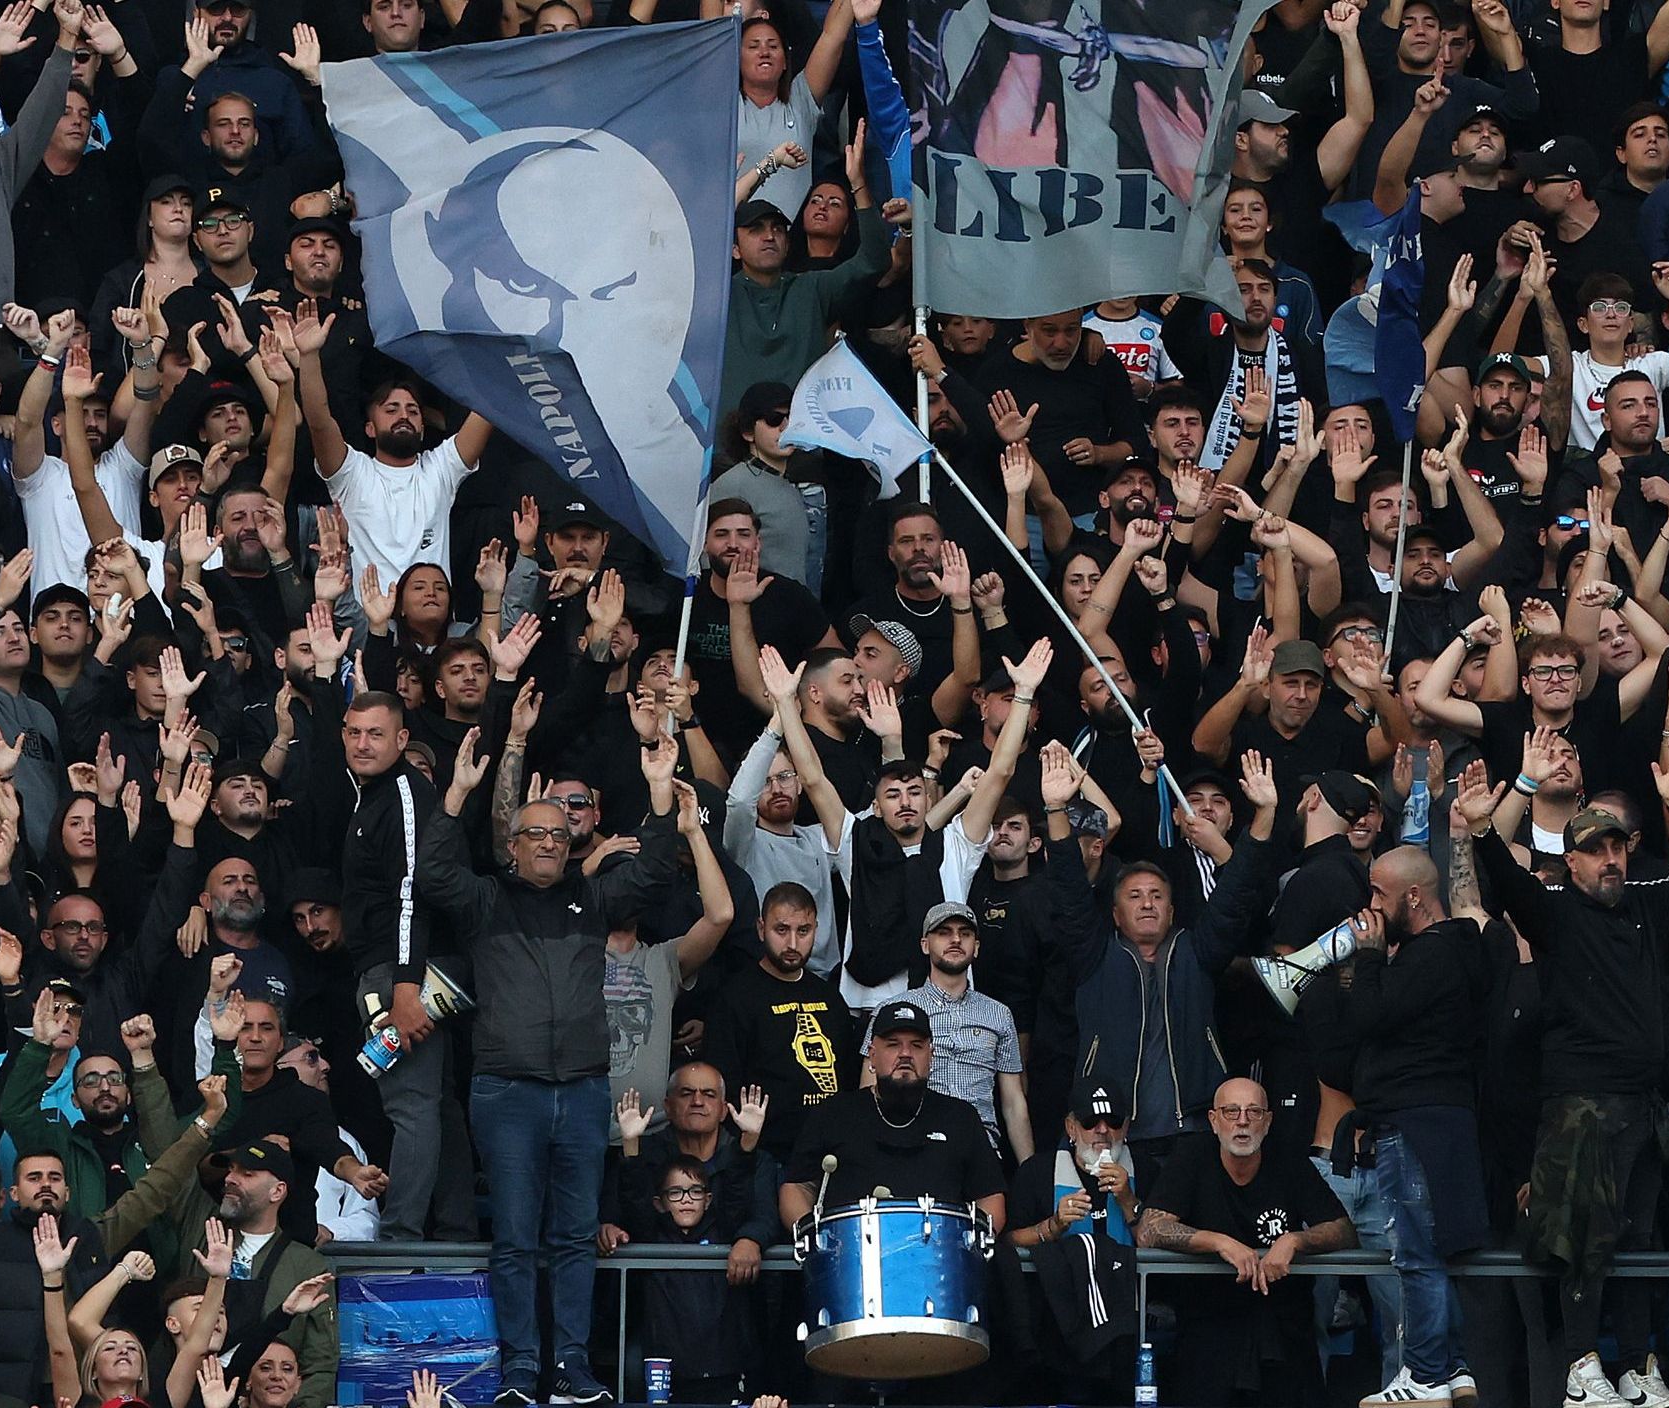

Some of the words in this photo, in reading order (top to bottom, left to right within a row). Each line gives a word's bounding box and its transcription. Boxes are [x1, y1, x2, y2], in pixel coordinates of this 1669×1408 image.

[208, 188, 222, 202] P
[1107, 345, 1149, 368] ete
[506, 351, 600, 481] NAPOLI
